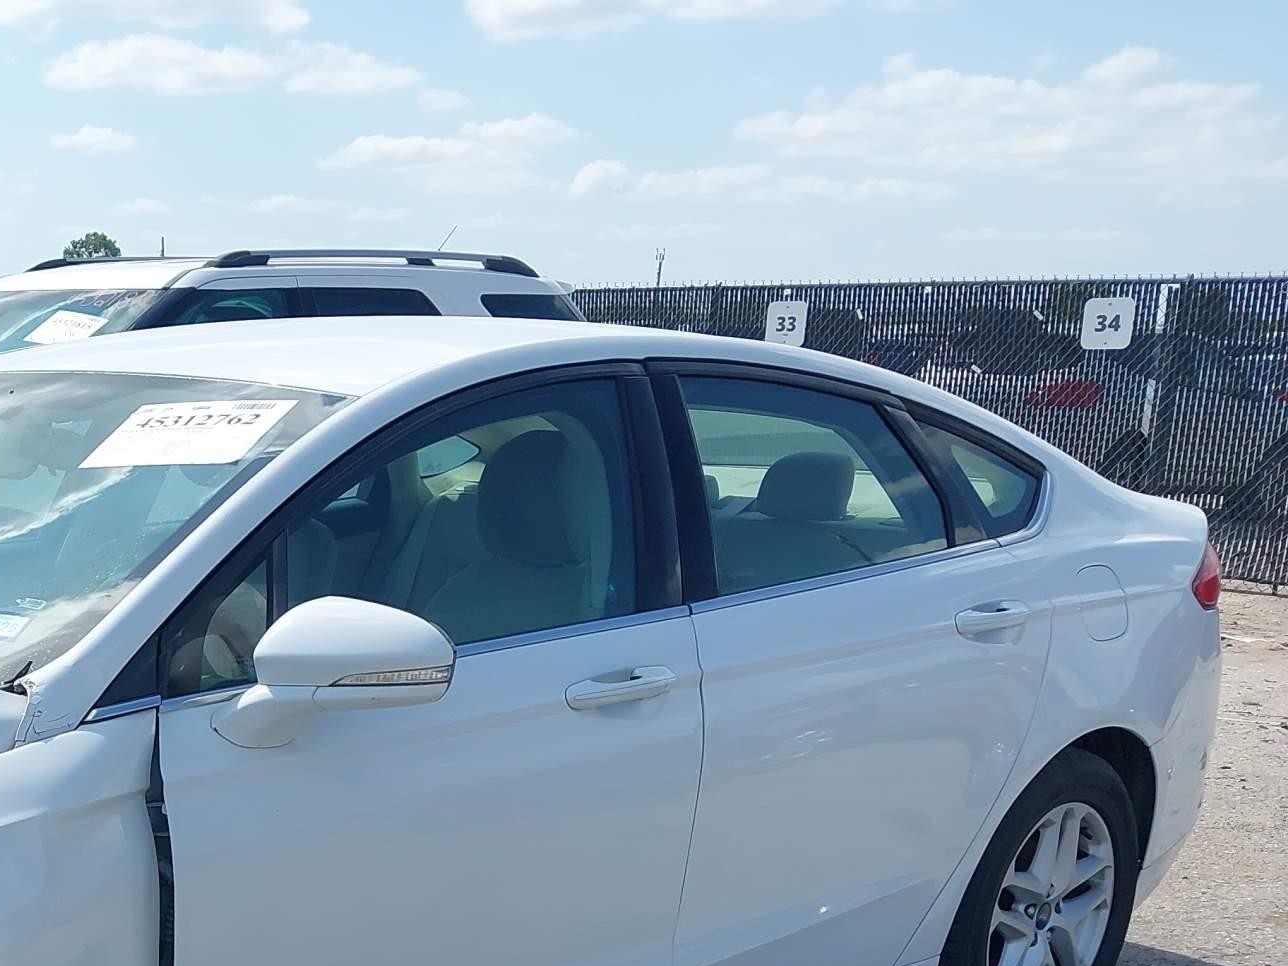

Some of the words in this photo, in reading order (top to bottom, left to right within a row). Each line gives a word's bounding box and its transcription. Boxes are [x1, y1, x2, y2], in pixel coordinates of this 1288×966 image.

[775, 316, 797, 332] 33
[1094, 314, 1121, 332] 34
[136, 413, 262, 430] 45312762
